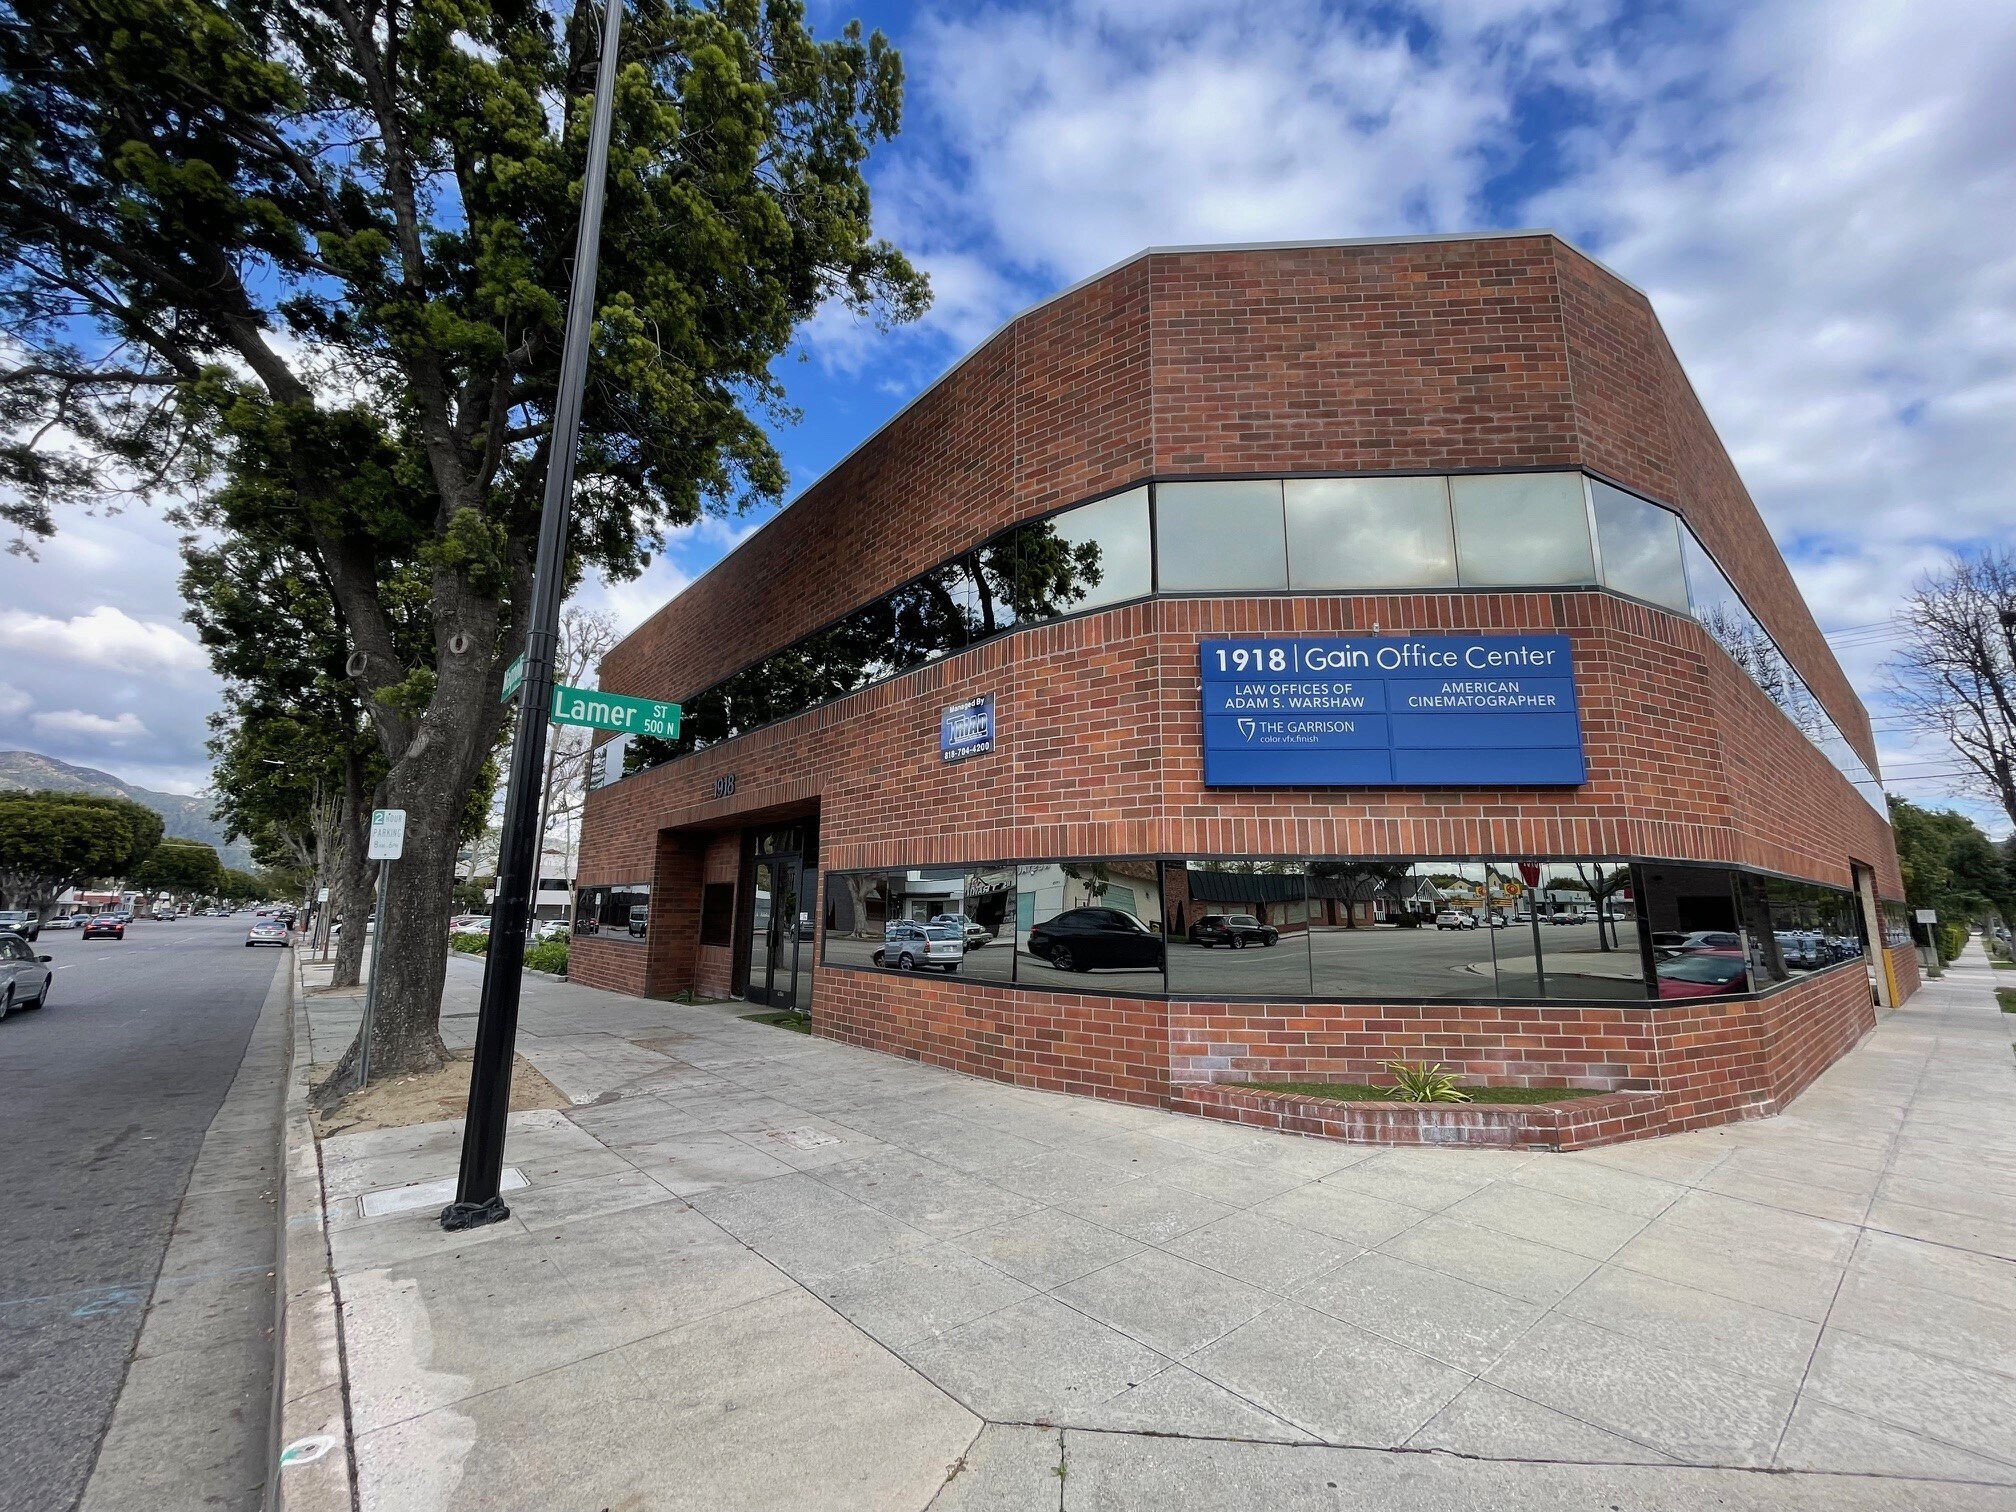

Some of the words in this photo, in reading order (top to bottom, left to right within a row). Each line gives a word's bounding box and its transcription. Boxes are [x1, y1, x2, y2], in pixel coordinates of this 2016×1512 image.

[1216, 648, 1286, 672] 1918
[1305, 644, 1369, 671] Gain
[1376, 643, 1458, 670] Office
[1465, 646, 1556, 669] Center
[1235, 684, 1266, 696] LAW
[1269, 683, 1329, 695] OFFICES
[1332, 683, 1353, 695] OF
[1441, 682, 1520, 694] AMERICAN
[949, 700, 976, 713] Managed
[976, 697, 985, 706] By
[1225, 697, 1268, 709] ADAM
[1273, 697, 1285, 709] S.
[1289, 696, 1365, 708] WARSHAW
[1408, 695, 1556, 707] CINEMATOGRAPHER
[555, 690, 637, 727] Lamer
[653, 704, 668, 718] ST
[644, 719, 664, 734] 500
[666, 722, 674, 735] N
[1259, 721, 1284, 733] THE
[1287, 721, 1355, 732] GARRISON
[944, 742, 990, 760] 818-704-4200
[713, 773, 736, 799] 1918
[374, 813, 383, 823] 2
[385, 814, 402, 823] HOUR
[373, 828, 401, 837] PARKING
